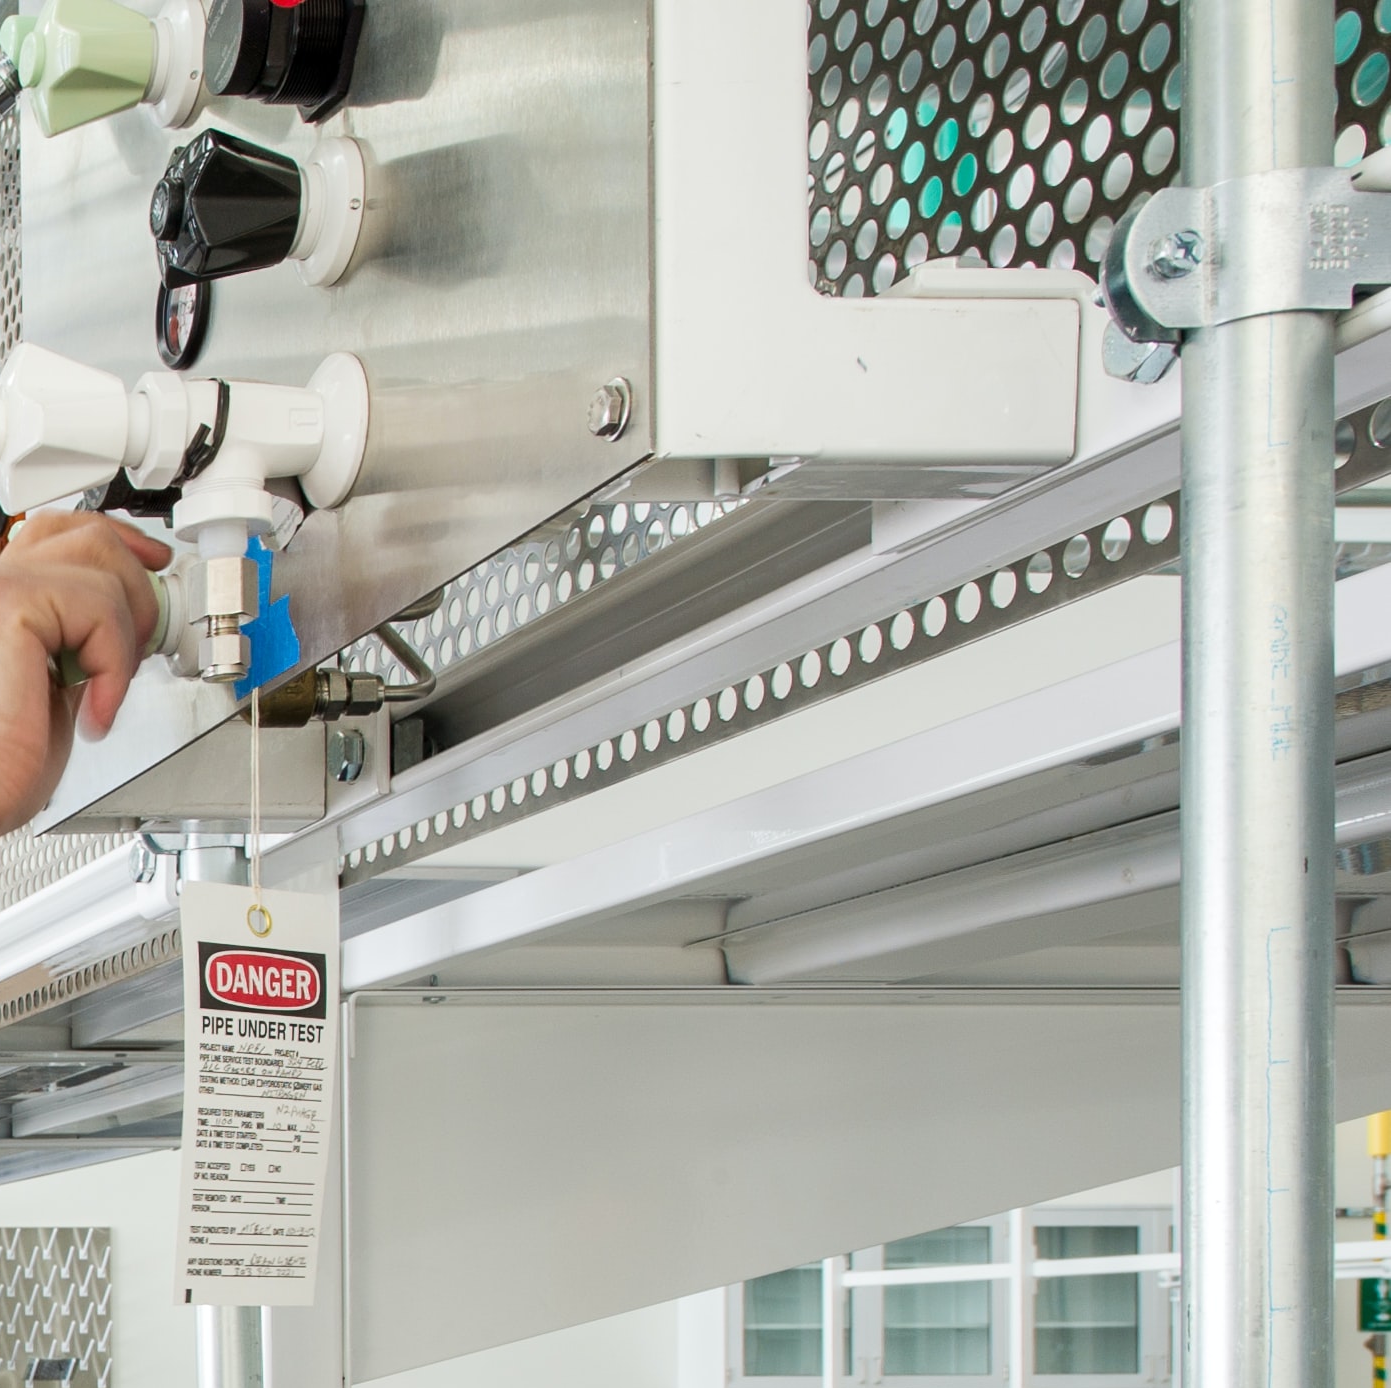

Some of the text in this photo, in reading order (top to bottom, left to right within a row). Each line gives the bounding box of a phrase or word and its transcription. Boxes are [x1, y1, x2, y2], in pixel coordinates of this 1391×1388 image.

[216, 961, 311, 1000] DANGER
[202, 1016, 324, 1043] PIPE UNDER TEST
[223, 1056, 241, 1064] SERVICE
[223, 1109, 233, 1117] TEST
